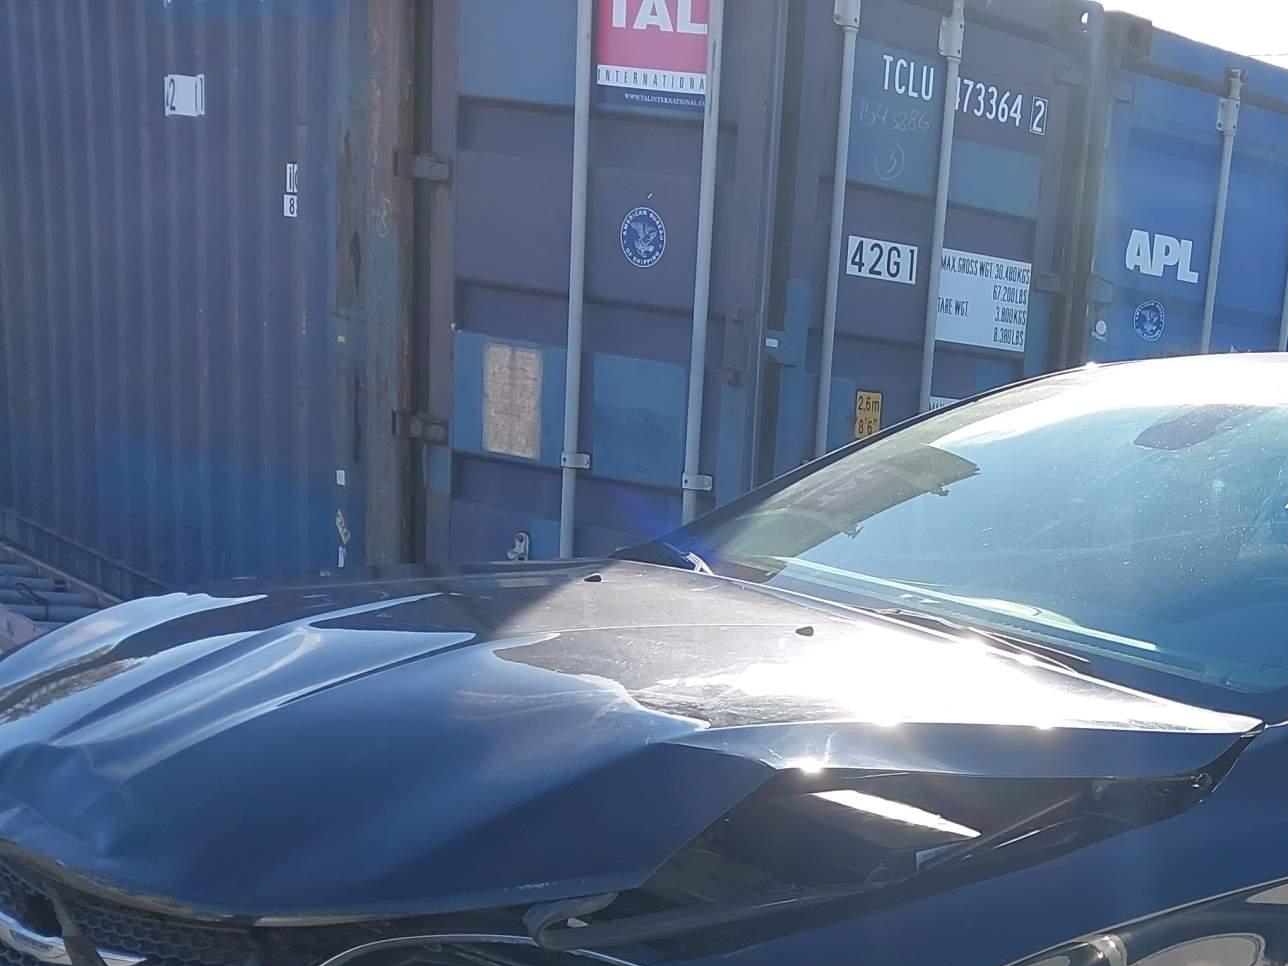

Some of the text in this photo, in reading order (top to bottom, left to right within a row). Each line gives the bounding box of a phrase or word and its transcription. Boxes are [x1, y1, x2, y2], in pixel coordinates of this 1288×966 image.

[597, 68, 705, 90] INTERNATIONA
[882, 54, 935, 101] TCLU
[1029, 96, 1048, 135] 2
[850, 239, 914, 282] 42G1
[1125, 228, 1199, 284] APL
